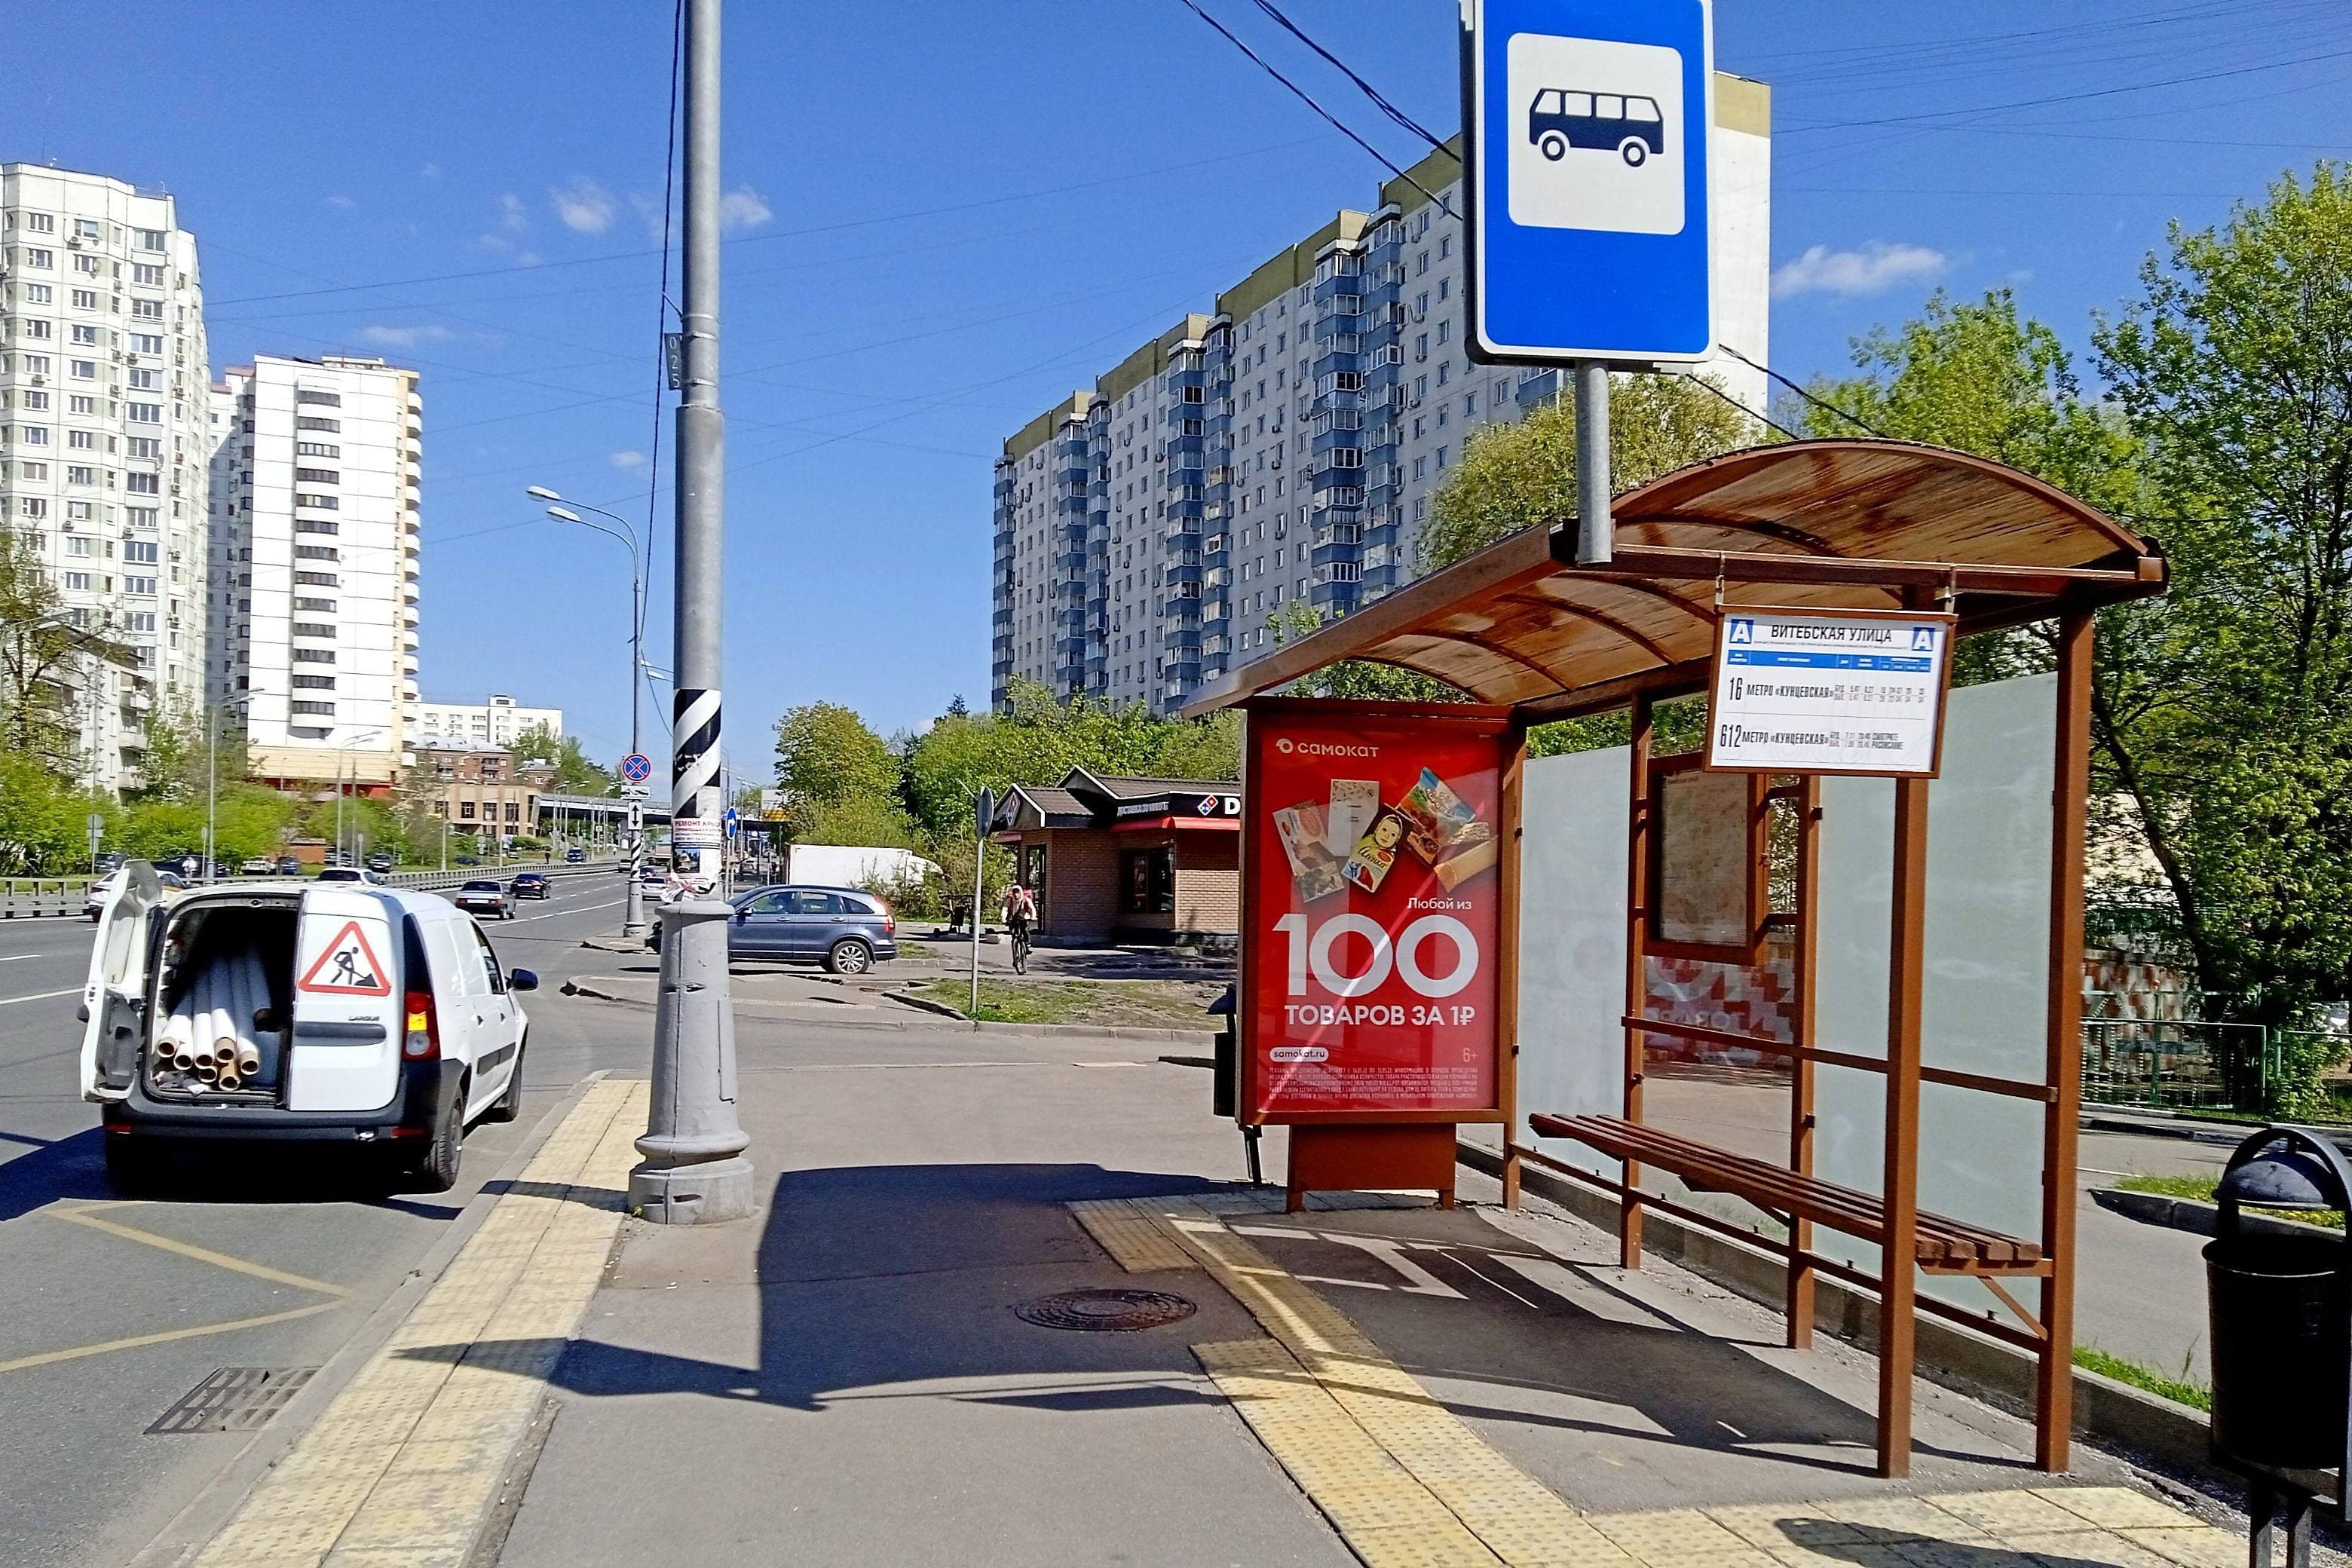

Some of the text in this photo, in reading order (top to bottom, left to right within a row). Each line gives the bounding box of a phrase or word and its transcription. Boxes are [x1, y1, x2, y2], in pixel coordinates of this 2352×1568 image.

[1771, 624, 1845, 640] ВИТЕБСКАЯ
[1849, 628, 1892, 644] УЛИЦА
[1729, 677, 1743, 700] 16
[1746, 684, 1774, 696] МЕТРО
[1775, 685, 1834, 699] «КУНЦЕВСКАЯ»
[1720, 724, 1742, 748] 612
[1741, 730, 1769, 743] МЕТРО
[1770, 732, 1829, 746] «КУНЦЕВСКАЯ»
[1297, 742, 1380, 758] самокат
[1407, 897, 1472, 910] Любой из
[1272, 913, 1479, 999] 100
[1284, 1004, 1406, 1026] ТОВАРОВ
[1410, 1005, 1445, 1026] ЗА
[1273, 1048, 1325, 1058] samokat.ru
[1462, 1047, 1478, 1063] 6+
